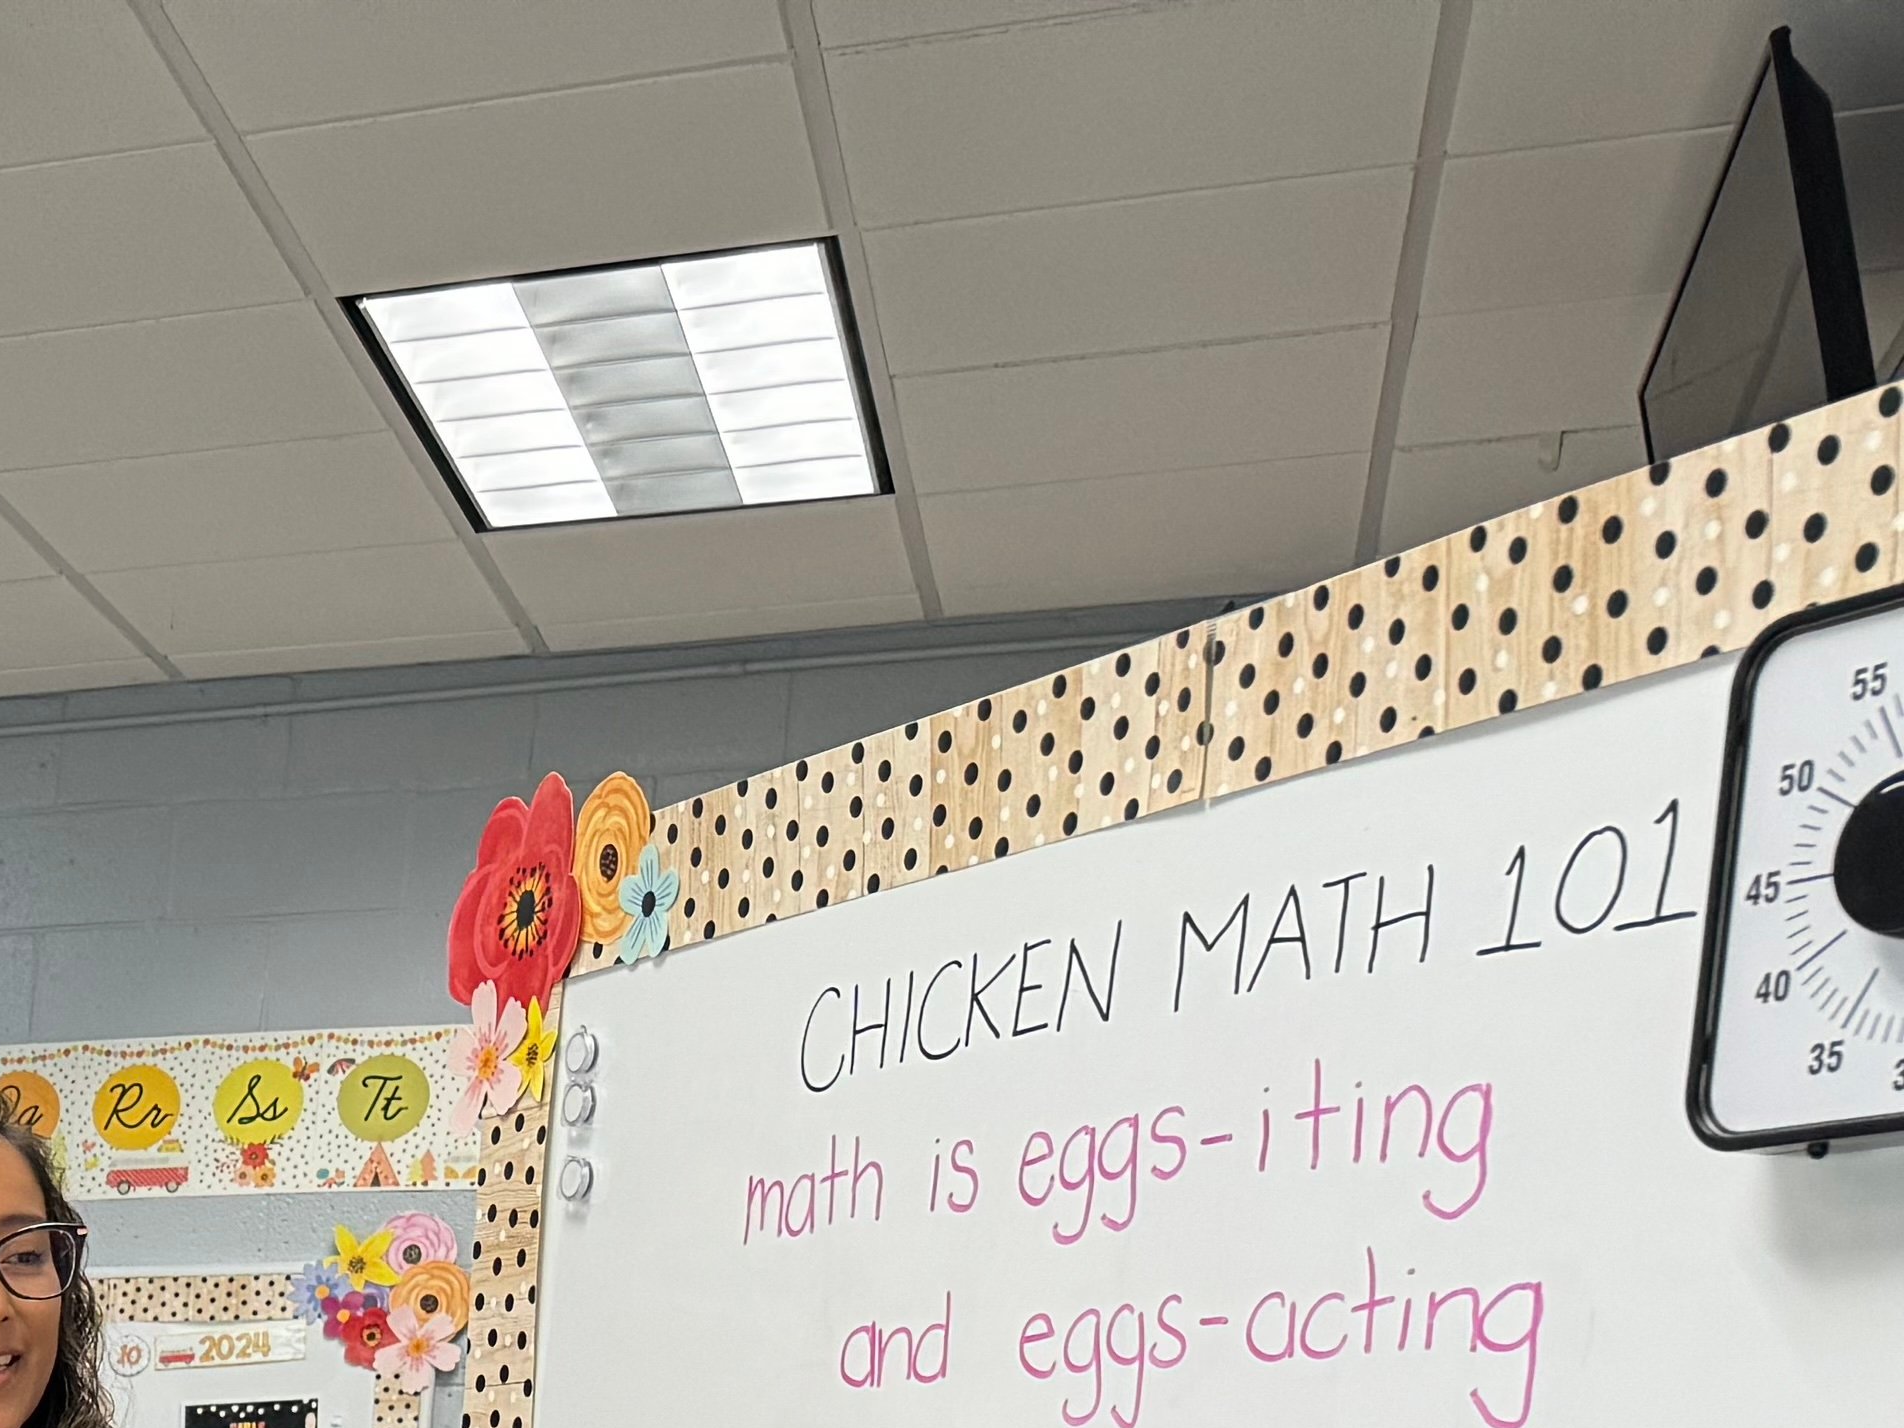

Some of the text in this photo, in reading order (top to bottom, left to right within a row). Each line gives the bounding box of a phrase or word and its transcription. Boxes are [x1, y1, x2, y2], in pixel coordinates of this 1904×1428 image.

[1850, 663, 1888, 702] 55
[1779, 760, 1815, 797] 50
[1745, 871, 1781, 905] 45
[798, 797, 1699, 1093] CHICKEN MATH 101
[1755, 970, 1791, 1004] 40
[1808, 1040, 1845, 1076] 35
[104, 1082, 174, 1133] Rr
[226, 1074, 289, 1126] Ss
[361, 1074, 411, 1123] Tt
[742, 1057, 1494, 1246] math is eggs-iting
[117, 1330, 272, 1369] 10 2024
[839, 1288, 951, 1389] and
